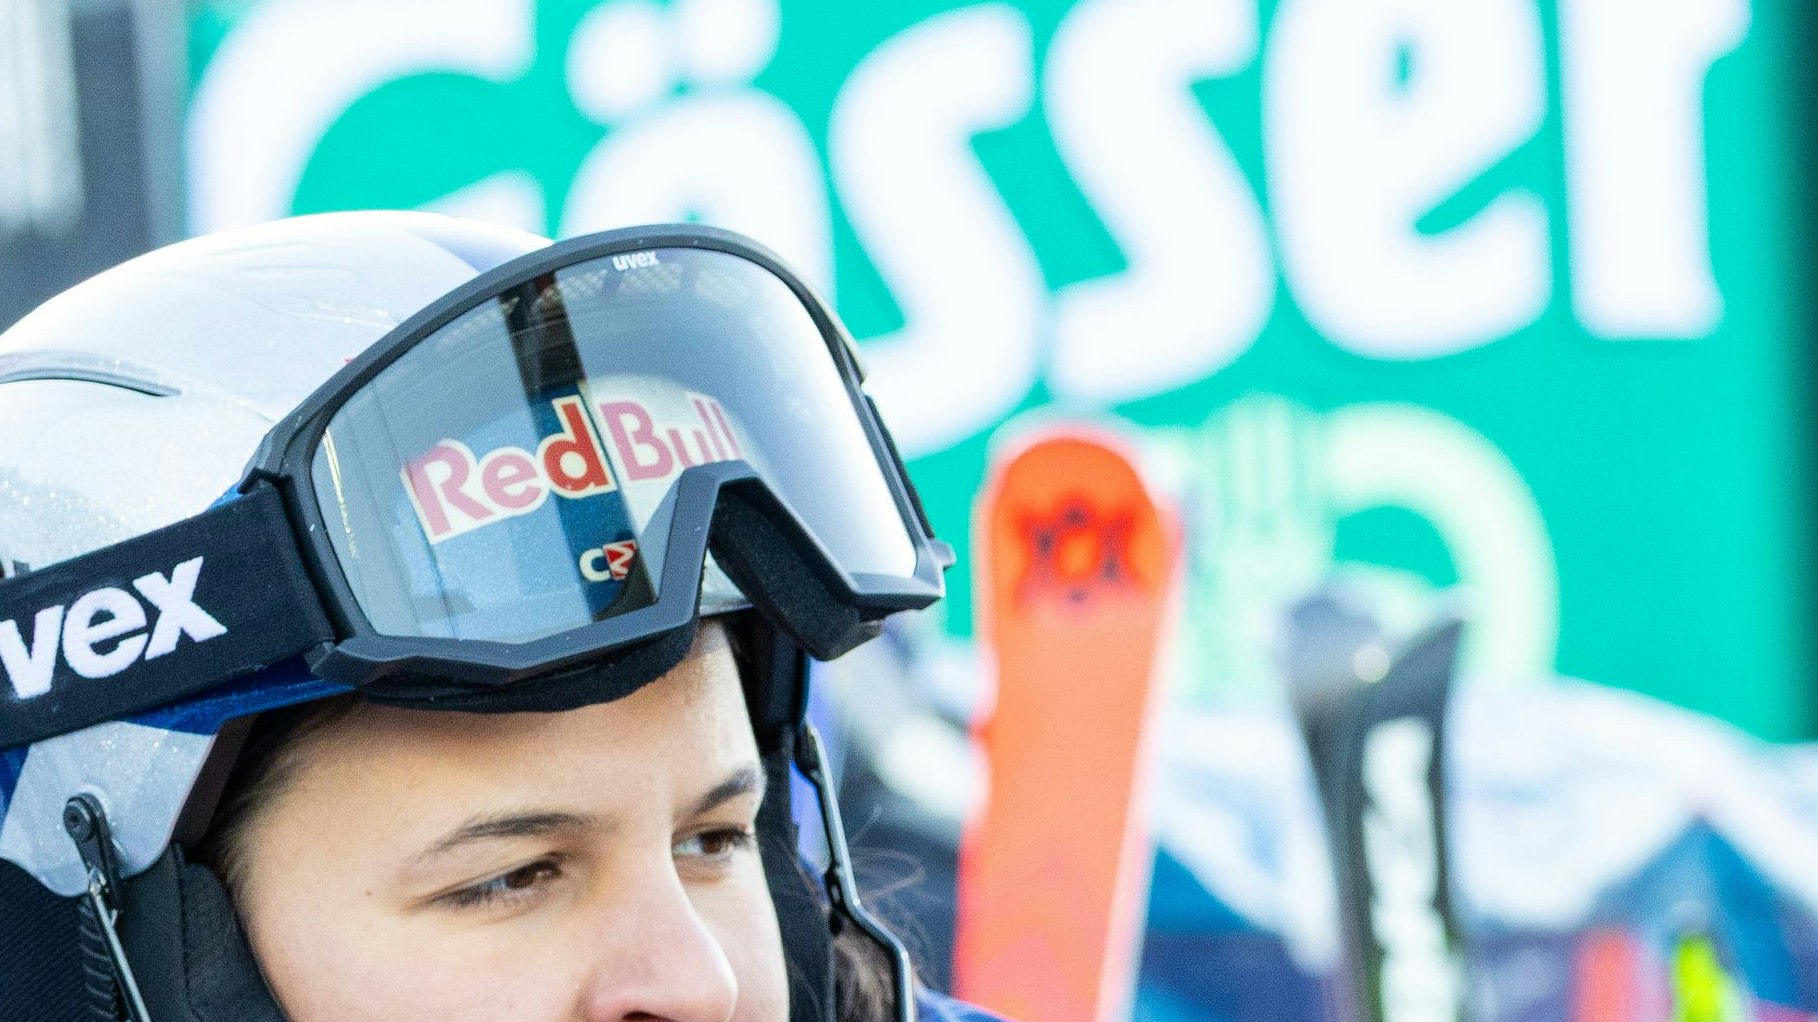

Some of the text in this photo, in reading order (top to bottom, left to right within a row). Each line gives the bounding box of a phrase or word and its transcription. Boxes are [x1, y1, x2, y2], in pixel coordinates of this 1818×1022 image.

[612, 251, 660, 271] uvex
[403, 397, 745, 537] Red Bull
